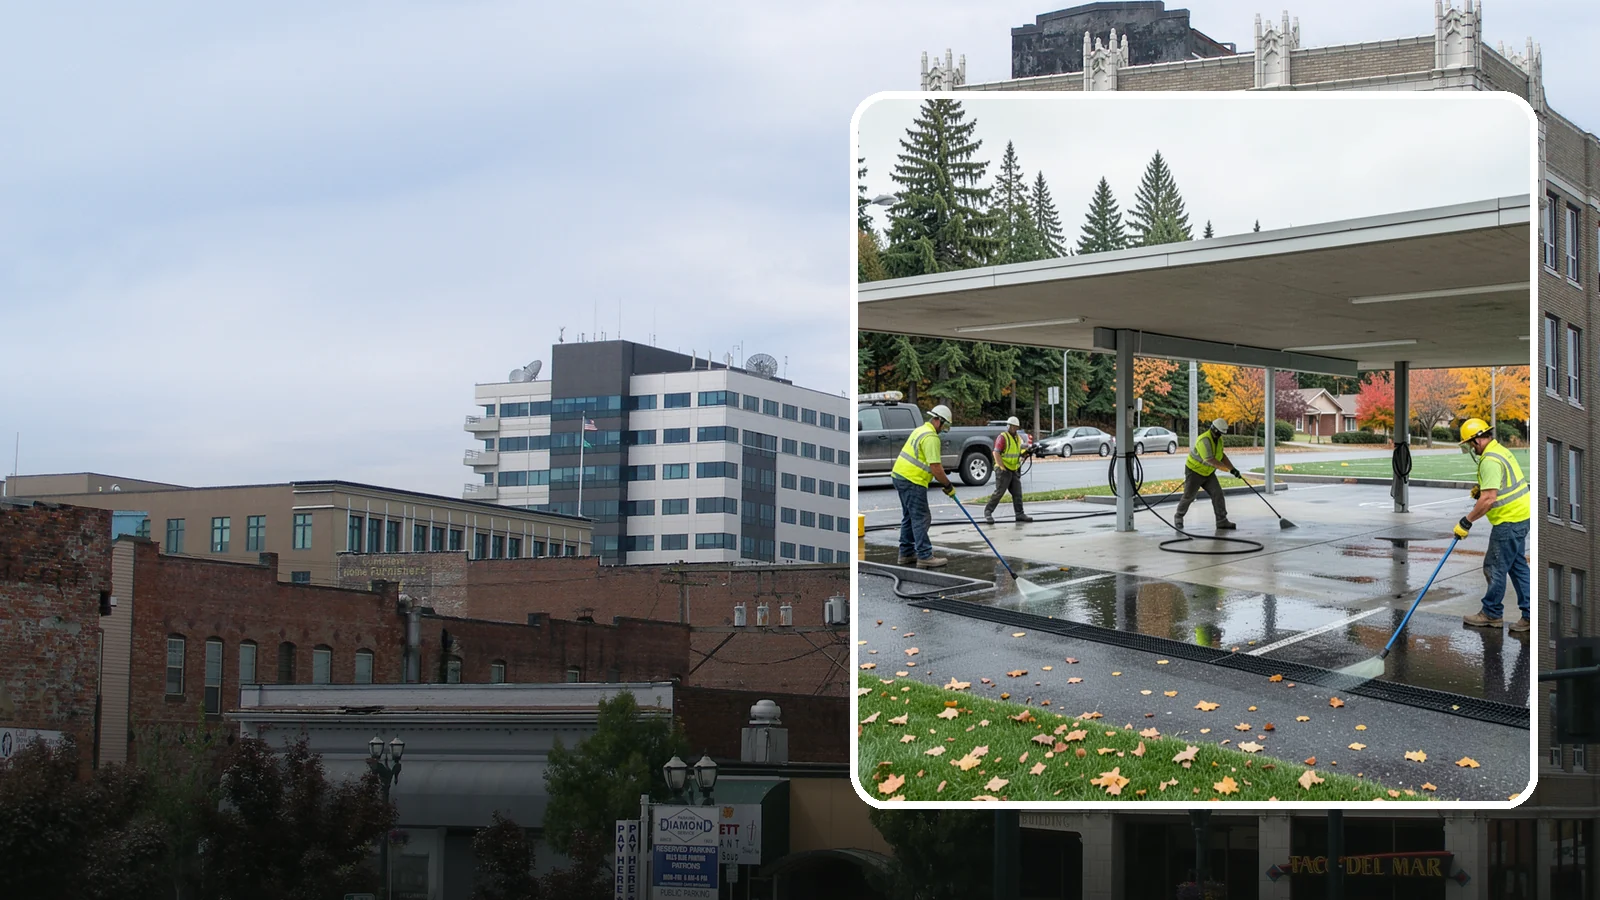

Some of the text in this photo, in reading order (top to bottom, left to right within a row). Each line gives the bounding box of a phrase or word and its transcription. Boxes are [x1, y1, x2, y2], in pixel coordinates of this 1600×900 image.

[343, 566, 427, 577] Home Furnishers
[660, 818, 713, 833] DIAMOND
[1021, 815, 1070, 828] BUILDING
[655, 845, 716, 854] RESERVED PARKING
[616, 825, 625, 893] PAY HERE
[627, 825, 636, 893] PAY HERE
[671, 862, 701, 870] PATRONS
[1289, 855, 1442, 877] TAC DEL MAR
[660, 888, 710, 898] PUBLIC PARKING
